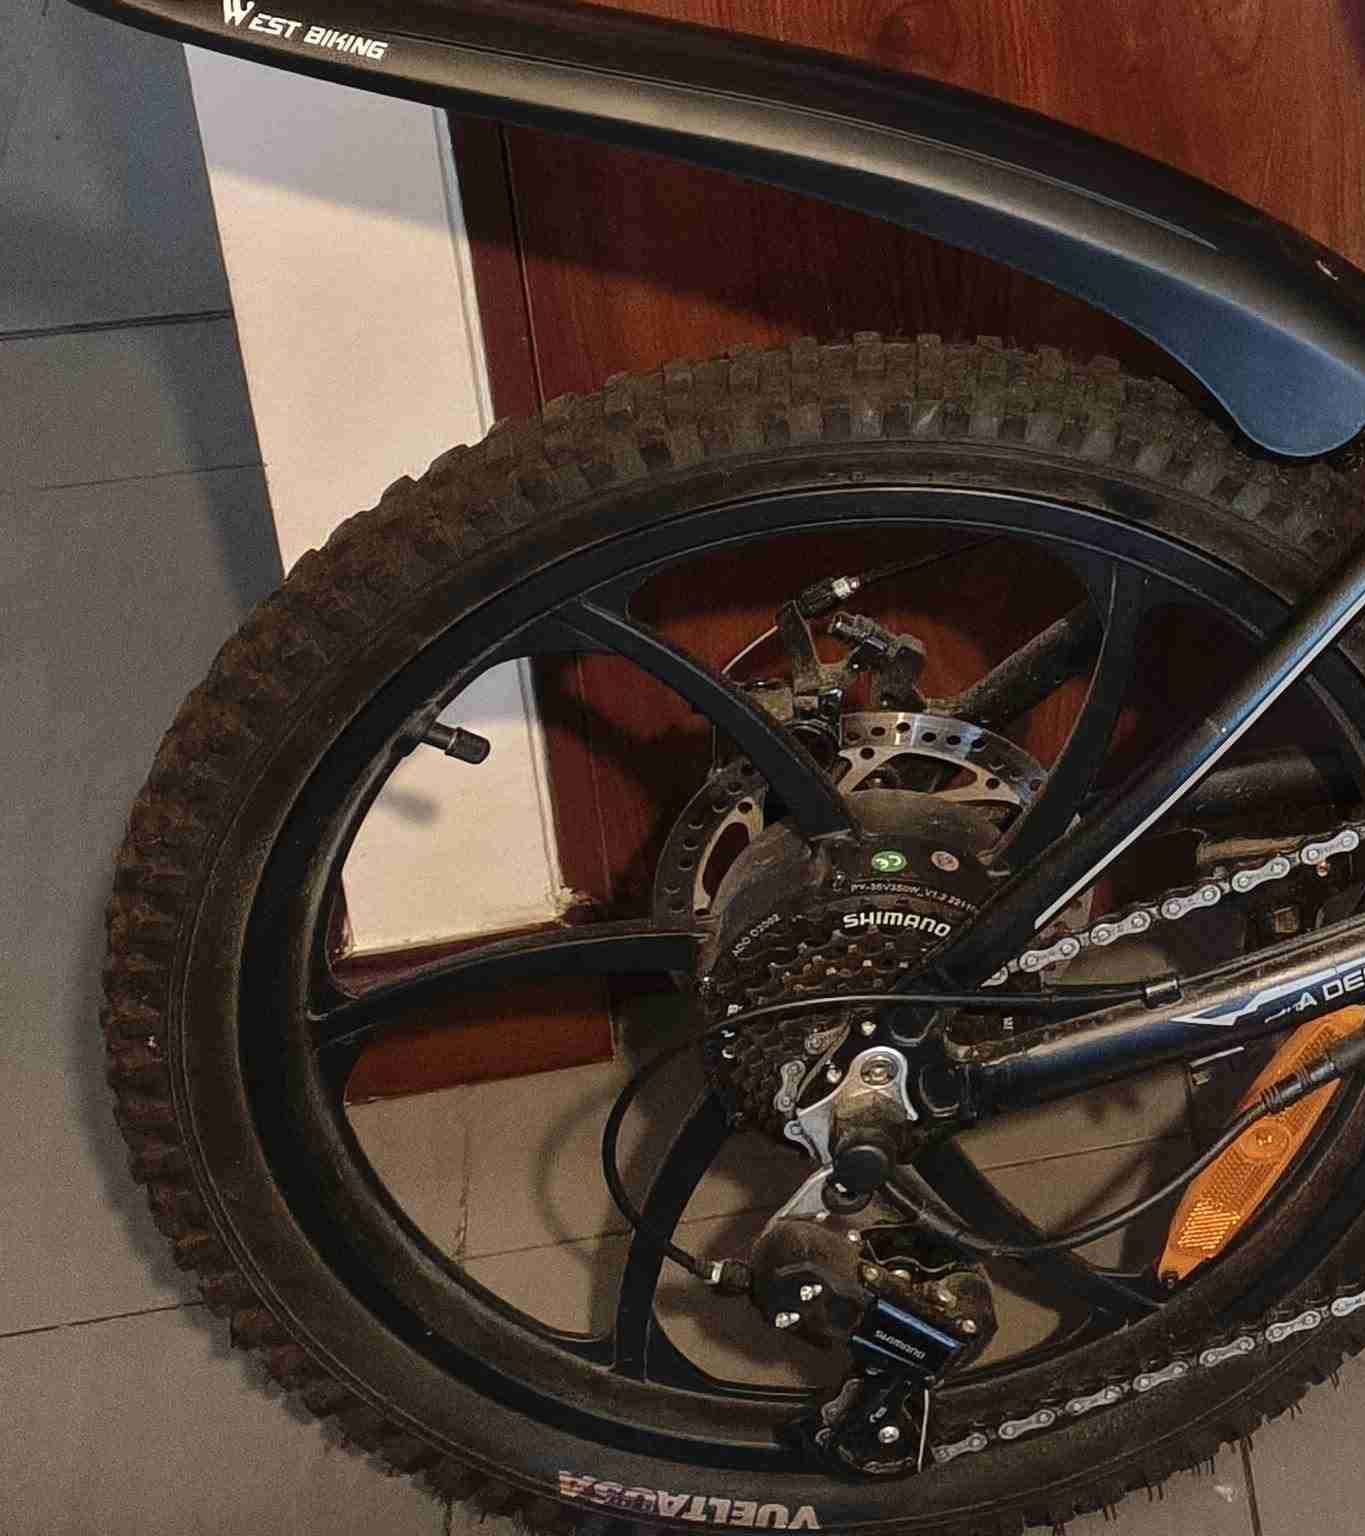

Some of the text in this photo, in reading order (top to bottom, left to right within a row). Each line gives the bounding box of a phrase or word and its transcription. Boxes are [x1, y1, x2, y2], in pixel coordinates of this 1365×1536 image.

[304, 25, 388, 60] BIKING
[843, 911, 951, 937] SHIMANO
[1296, 992, 1318, 1011] A
